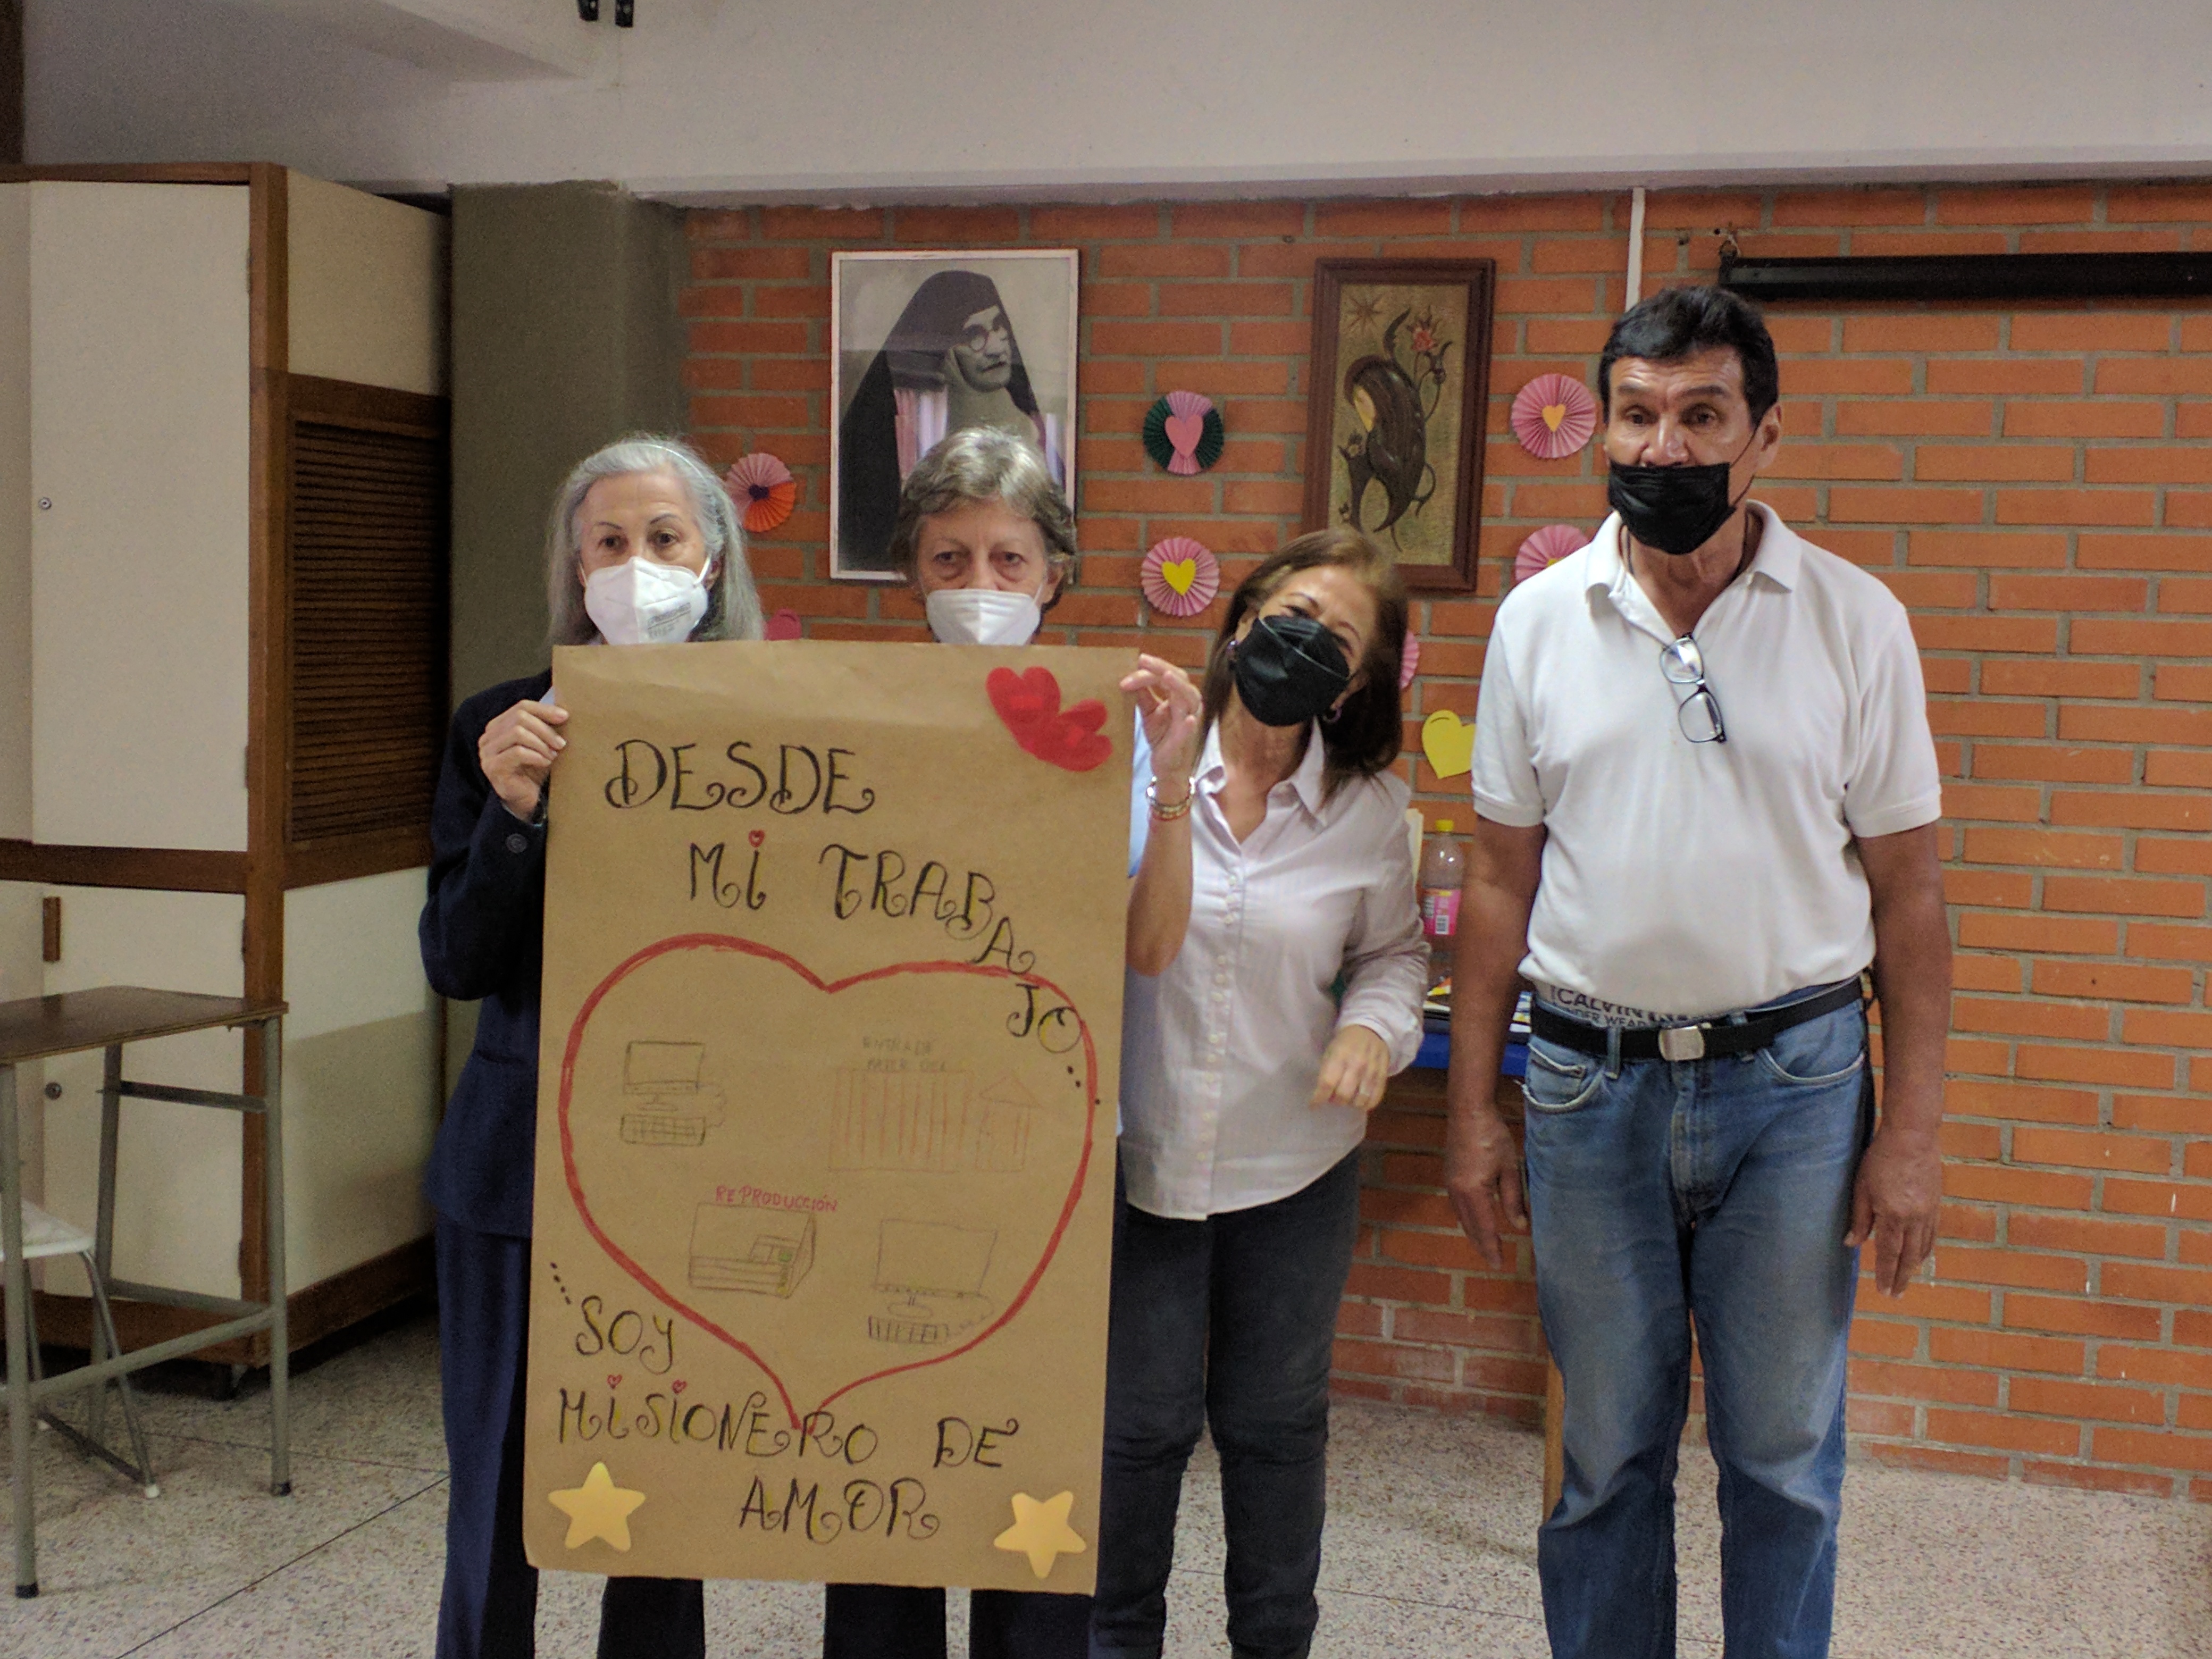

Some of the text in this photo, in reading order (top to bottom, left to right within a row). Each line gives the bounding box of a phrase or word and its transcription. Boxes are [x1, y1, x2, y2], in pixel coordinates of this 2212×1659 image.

[605, 739, 875, 815] DESDE
[715, 1183, 839, 1213] REPRODUCCIÓN
[933, 1417, 1019, 1468] DE
[739, 1476, 940, 1543] AMOR
